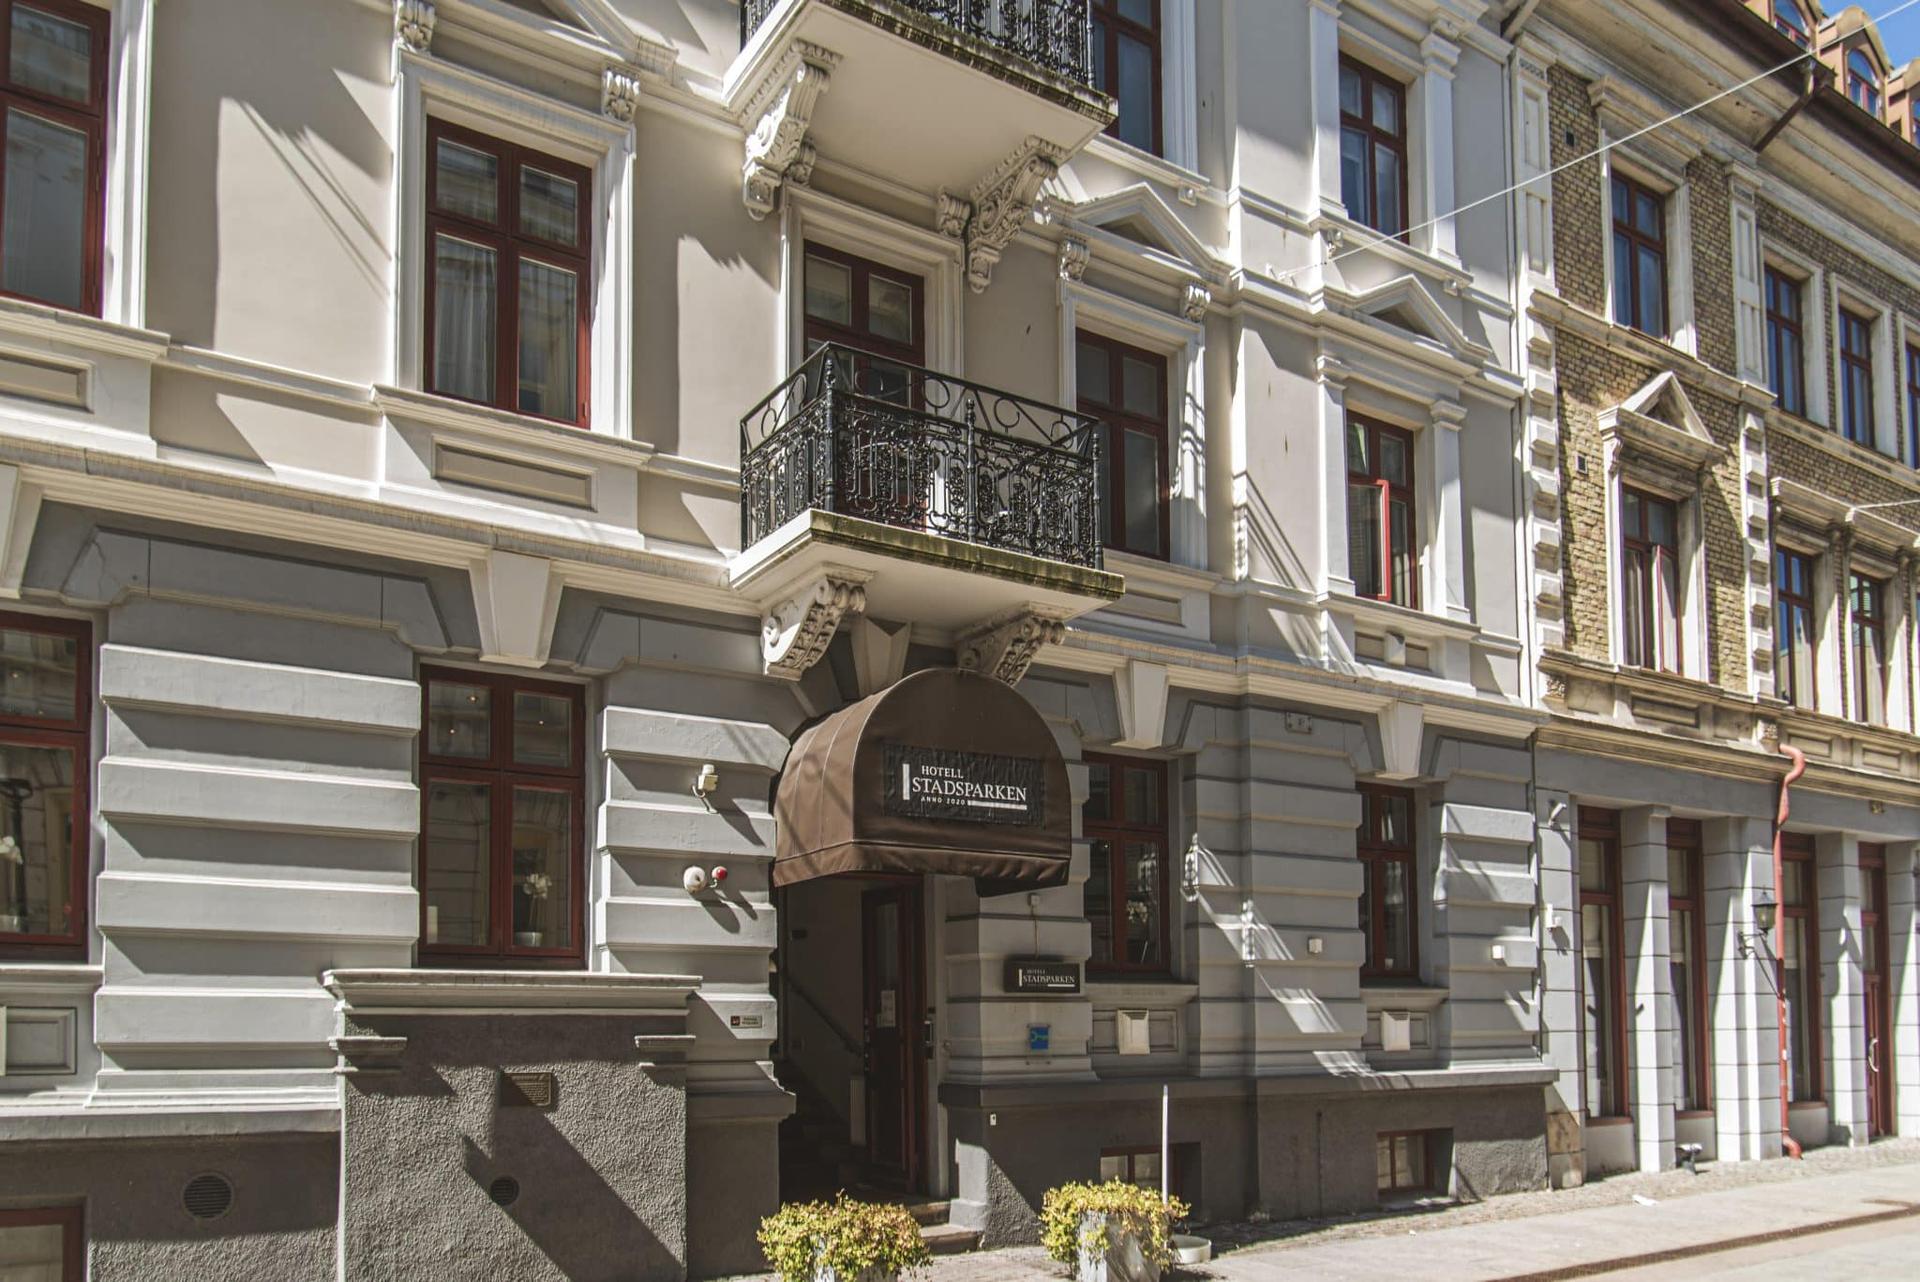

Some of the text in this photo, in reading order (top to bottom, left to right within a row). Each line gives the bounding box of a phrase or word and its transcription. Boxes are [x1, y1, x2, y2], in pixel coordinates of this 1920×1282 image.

[921, 765, 964, 779] HOTELL
[912, 777, 1027, 801] STADSPARKEN
[920, 796, 965, 805] ANNO 2020
